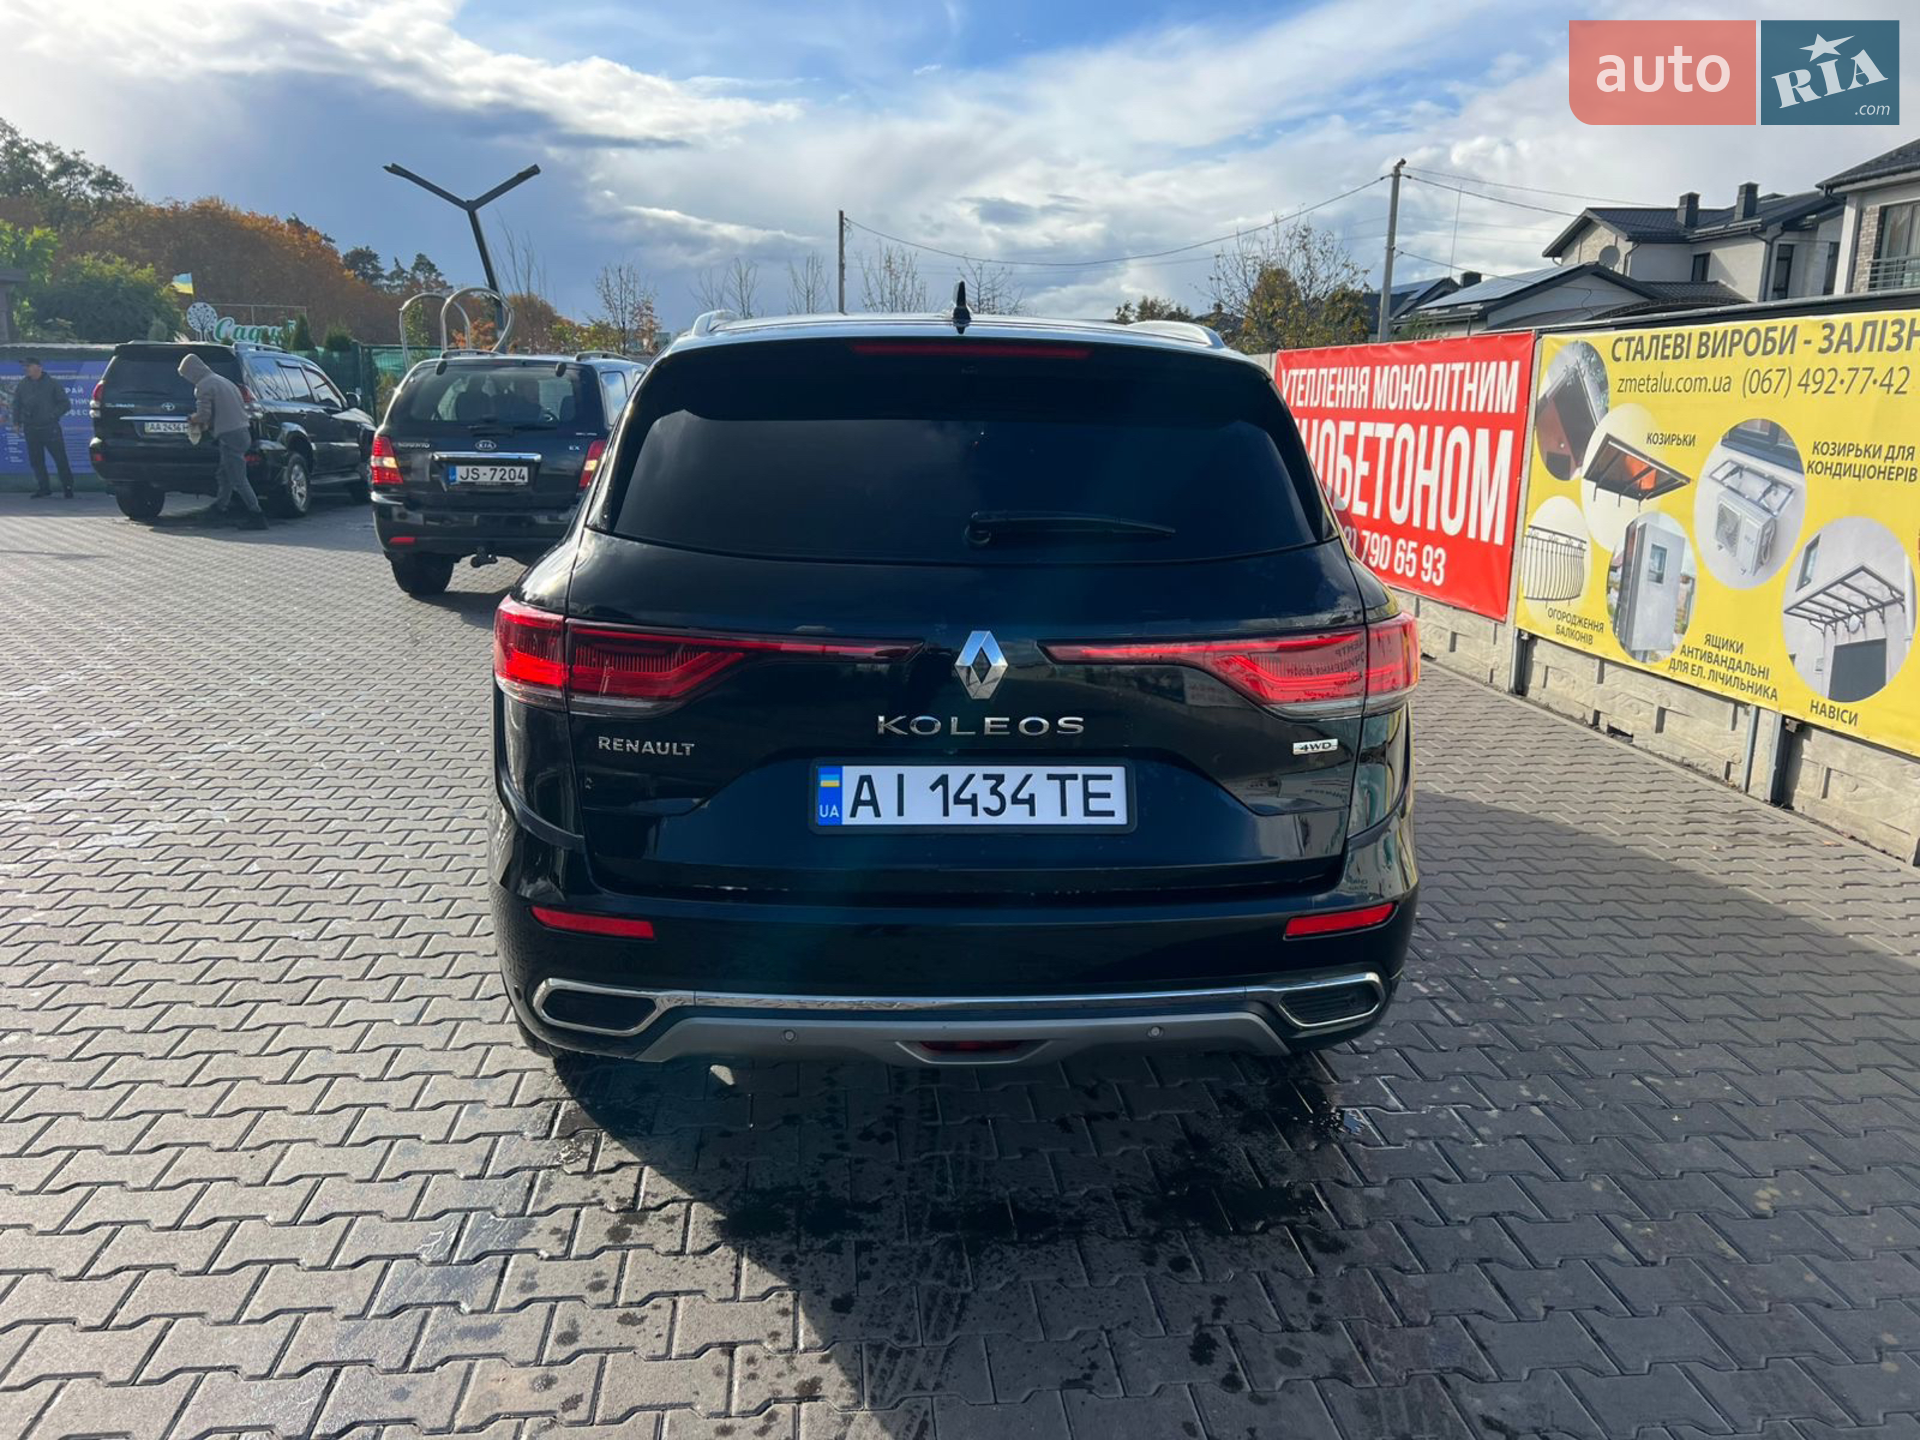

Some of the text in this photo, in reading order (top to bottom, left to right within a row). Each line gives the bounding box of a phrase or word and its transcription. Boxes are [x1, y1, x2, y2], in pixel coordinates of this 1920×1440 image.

[1611, 332, 1692, 362] СТАЛЕВІ
[1696, 325, 1798, 360] ВИРОБИ
[1282, 360, 1520, 414] УТЕПЛЕННЯ МОНОЛІТНИМ
[1617, 371, 1732, 394] zmetalu.com.ua
[1742, 366, 1792, 399] (067)
[1646, 432, 1696, 447] КОЗИРЬКИ
[1812, 441, 1915, 463] КОЗИРЬКИ ДЛЯ
[460, 467, 525, 481] JS-7204
[1295, 417, 1514, 546] НОБЕТОНОМ
[1806, 461, 1918, 483] КОНДИЦІОНЕРІВ
[1360, 530, 1392, 570] 790
[1394, 538, 1418, 578] 65
[1421, 545, 1446, 586] 93
[1547, 607, 1604, 634] ОГОРОДЖЕННЯ
[1556, 624, 1593, 645] БАЛКОНІВ
[1704, 634, 1744, 655] ЯЩИКИ
[1679, 644, 1770, 680] АНТИВАНДАЛЬНІ
[1668, 657, 1778, 701] ДЛЯ ЕЛ. ЛІЧИЛЬНИКА
[1809, 699, 1859, 726] НАВІСИ
[877, 715, 1085, 736] KOLEOS
[598, 736, 695, 757] RENAULT
[1300, 741, 1332, 752] 4WD
[819, 804, 840, 818] UA
